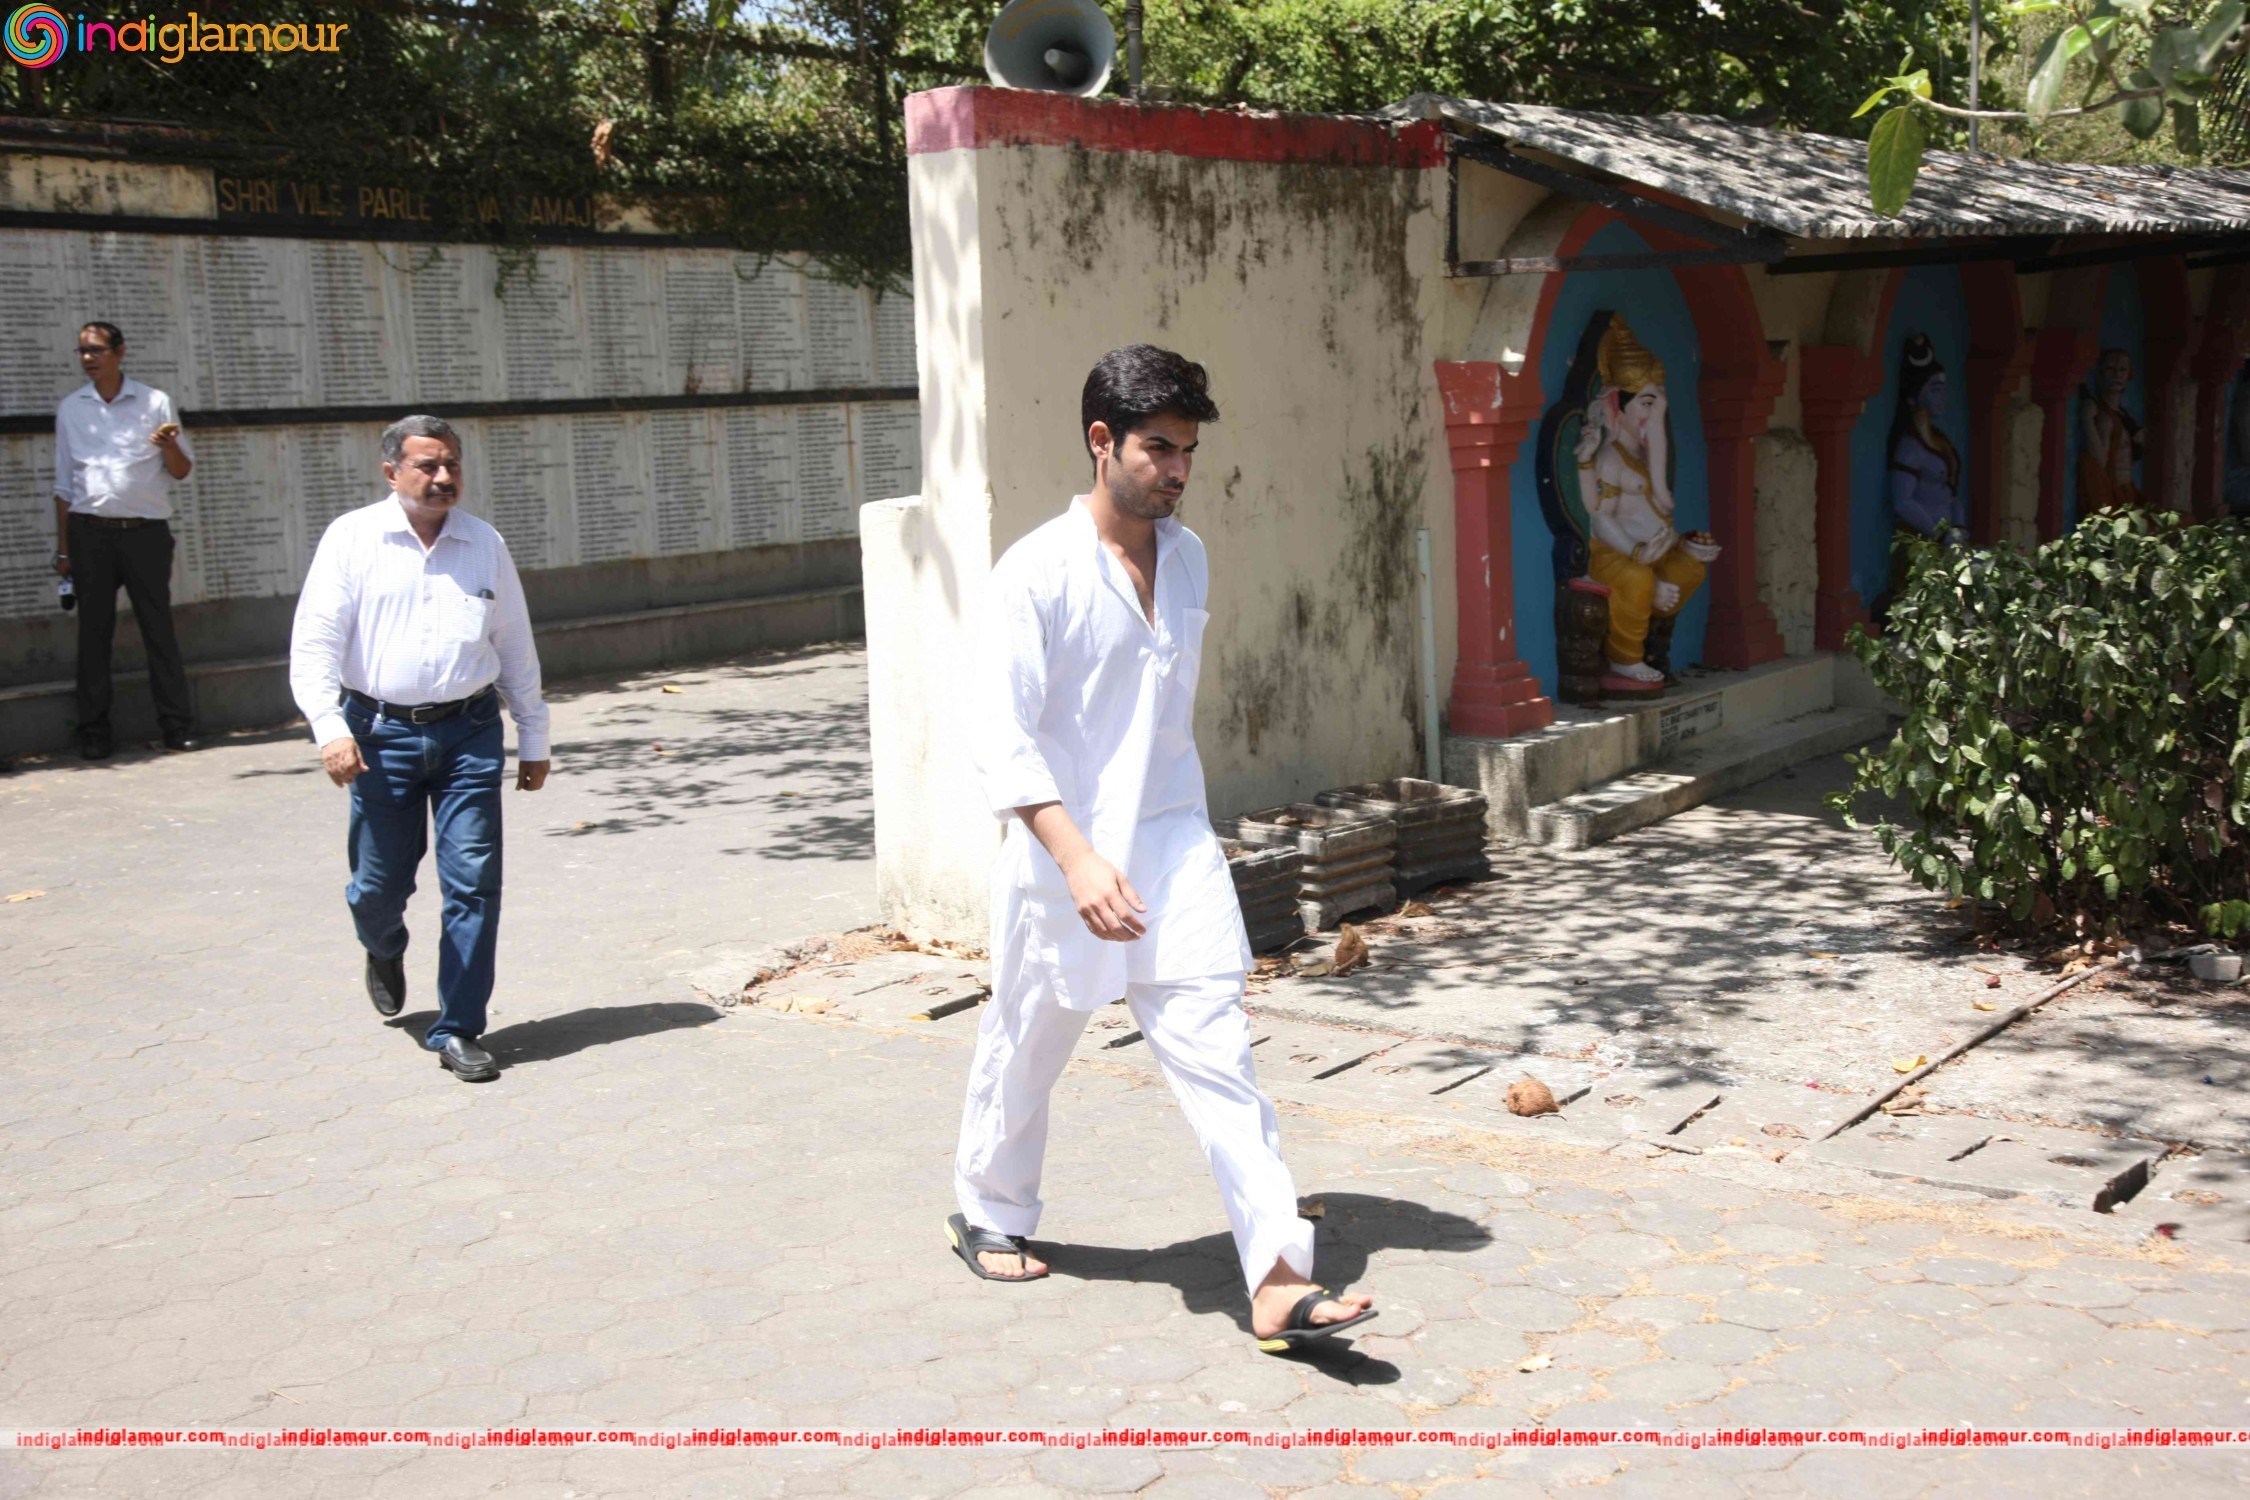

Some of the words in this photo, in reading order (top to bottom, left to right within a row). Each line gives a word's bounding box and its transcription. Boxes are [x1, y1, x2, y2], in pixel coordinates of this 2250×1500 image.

[220, 178, 278, 214] SHRI
[290, 181, 345, 217] VILE
[358, 186, 432, 221] PARLE
